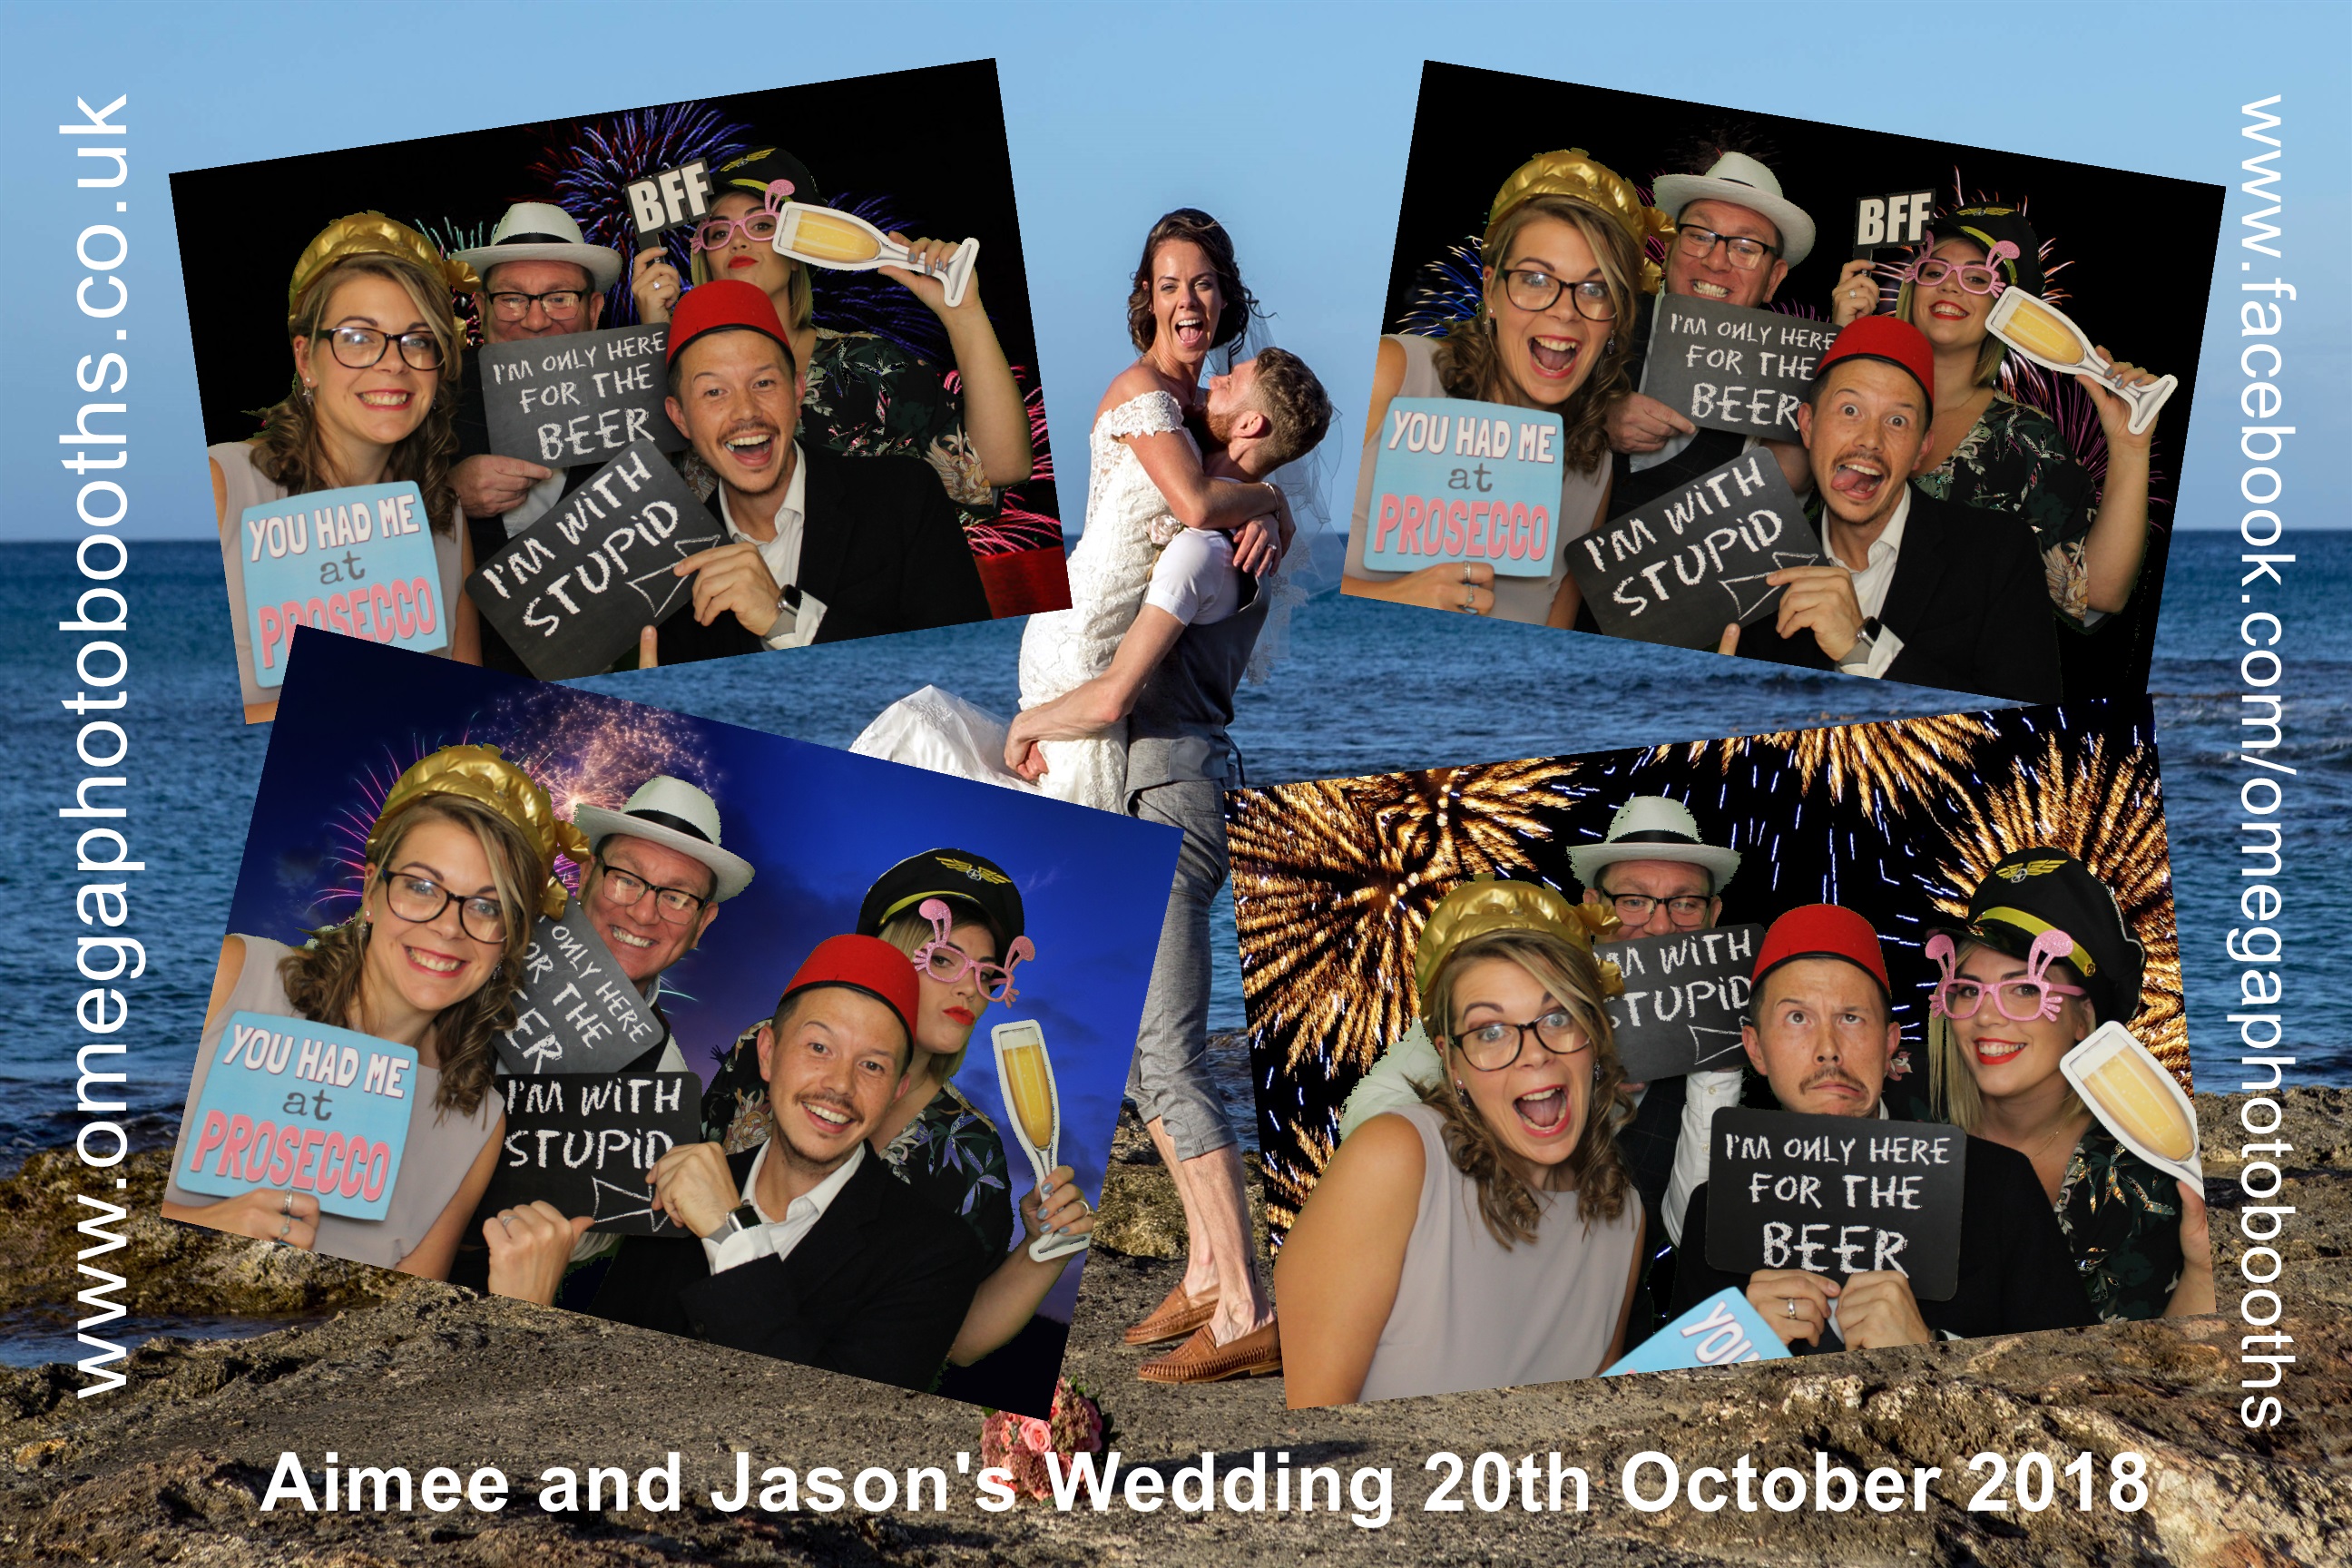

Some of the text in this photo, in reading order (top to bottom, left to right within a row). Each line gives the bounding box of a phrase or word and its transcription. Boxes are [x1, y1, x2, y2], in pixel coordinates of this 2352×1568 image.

[627, 162, 709, 234] BFF
[1857, 192, 1932, 246] BFF
[493, 331, 667, 386] I'M ONLY HERE
[1671, 313, 1838, 351] I'M ONLY HERE
[519, 363, 654, 414] FOR THE
[1686, 344, 1817, 381] FOR THE
[1690, 382, 1802, 431] BEER
[537, 407, 656, 462] BEER
[1387, 409, 1557, 464] YOU HAD ME
[1447, 462, 1494, 493] at
[247, 494, 421, 563] YOU HAD ME
[1373, 493, 1550, 562] PROSECCO
[1583, 518, 1658, 573] I'M
[319, 550, 366, 585] at
[482, 537, 556, 600] I'M
[523, 942, 613, 1050] OR THE
[551, 925, 652, 1044] ONLY HERE
[505, 987, 564, 1074] ER
[222, 1023, 410, 1099] YOU HAD ME
[281, 1089, 333, 1122] at
[506, 1079, 564, 1115] I'M
[189, 1109, 391, 1202] PROSECCO
[1725, 1133, 1952, 1166] I'M ONLY HERE
[1748, 1171, 1925, 1210] FOR THE
[1763, 1221, 1910, 1279] BEER
